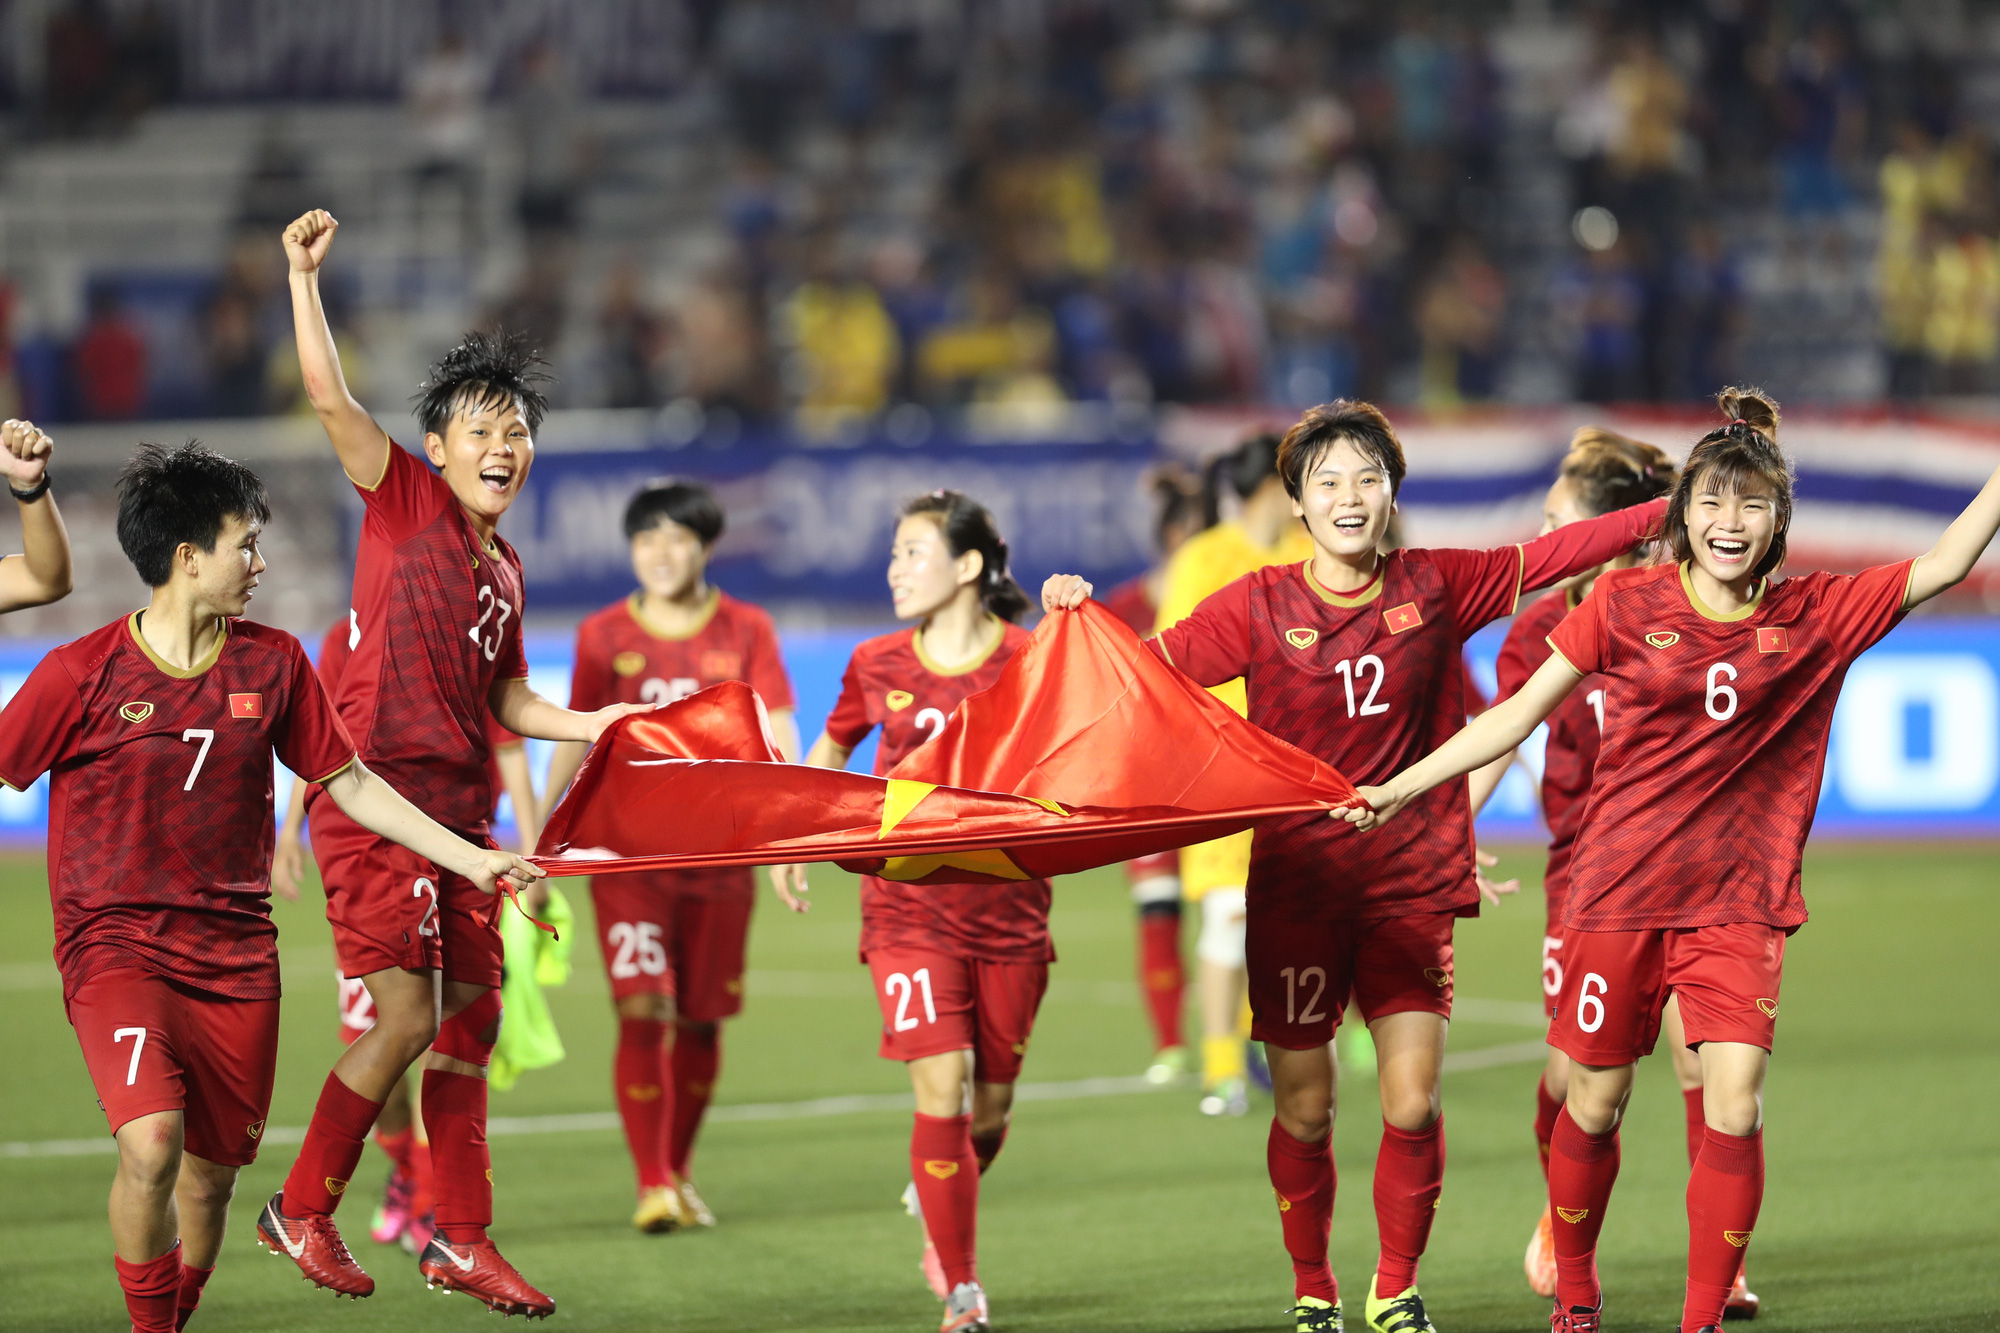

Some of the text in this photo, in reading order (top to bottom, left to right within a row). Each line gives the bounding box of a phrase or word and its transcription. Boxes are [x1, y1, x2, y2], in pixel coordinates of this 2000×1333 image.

[468, 585, 512, 661] 23
[1335, 655, 1390, 718] 12
[1586, 689, 1607, 738] 1
[1705, 662, 1738, 721] 6
[914, 707, 955, 743] 2
[182, 728, 214, 791] 7
[413, 877, 440, 937] 2
[607, 922, 668, 979] 25
[885, 967, 937, 1032] 21
[1280, 966, 1327, 1024] 12
[1577, 972, 1608, 1033] 6
[113, 1027, 147, 1086] 7
